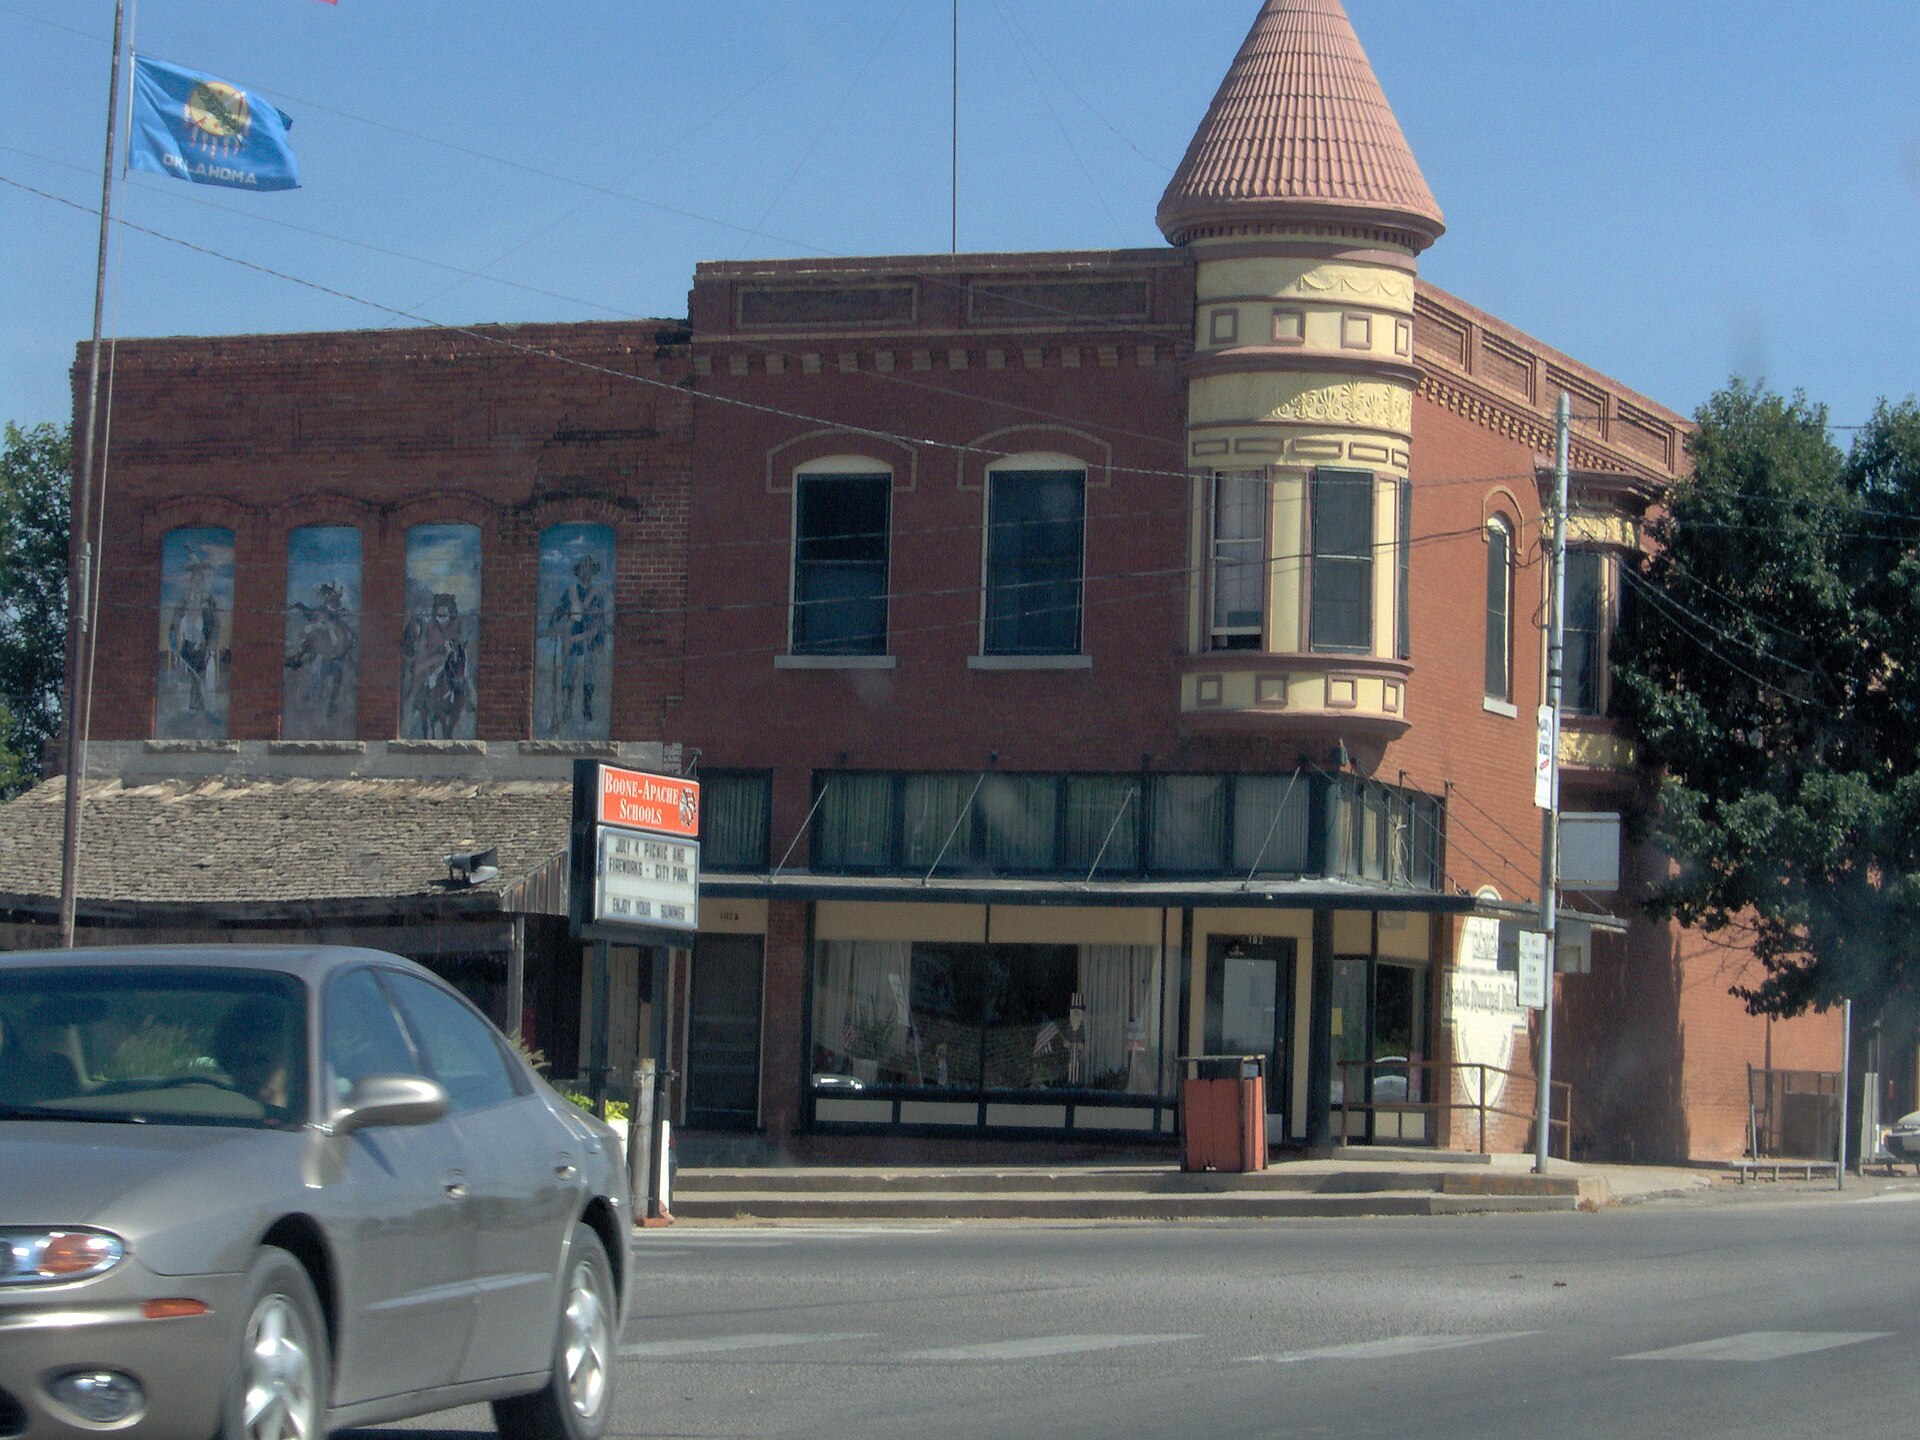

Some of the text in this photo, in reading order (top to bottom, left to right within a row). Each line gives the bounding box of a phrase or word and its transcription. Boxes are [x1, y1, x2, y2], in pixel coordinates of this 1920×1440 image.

[163, 153, 257, 184] OKLAHOMA
[604, 772, 679, 805] BOONE-APACHE
[619, 798, 662, 824] SCHOOLS
[615, 839, 630, 854] JULY
[644, 842, 668, 860] PICNIC
[609, 857, 642, 876] FIREWORKS
[655, 864, 669, 879] CITY
[673, 867, 689, 882] PARK
[613, 897, 685, 919] ENJOY YOUR SUMMER
